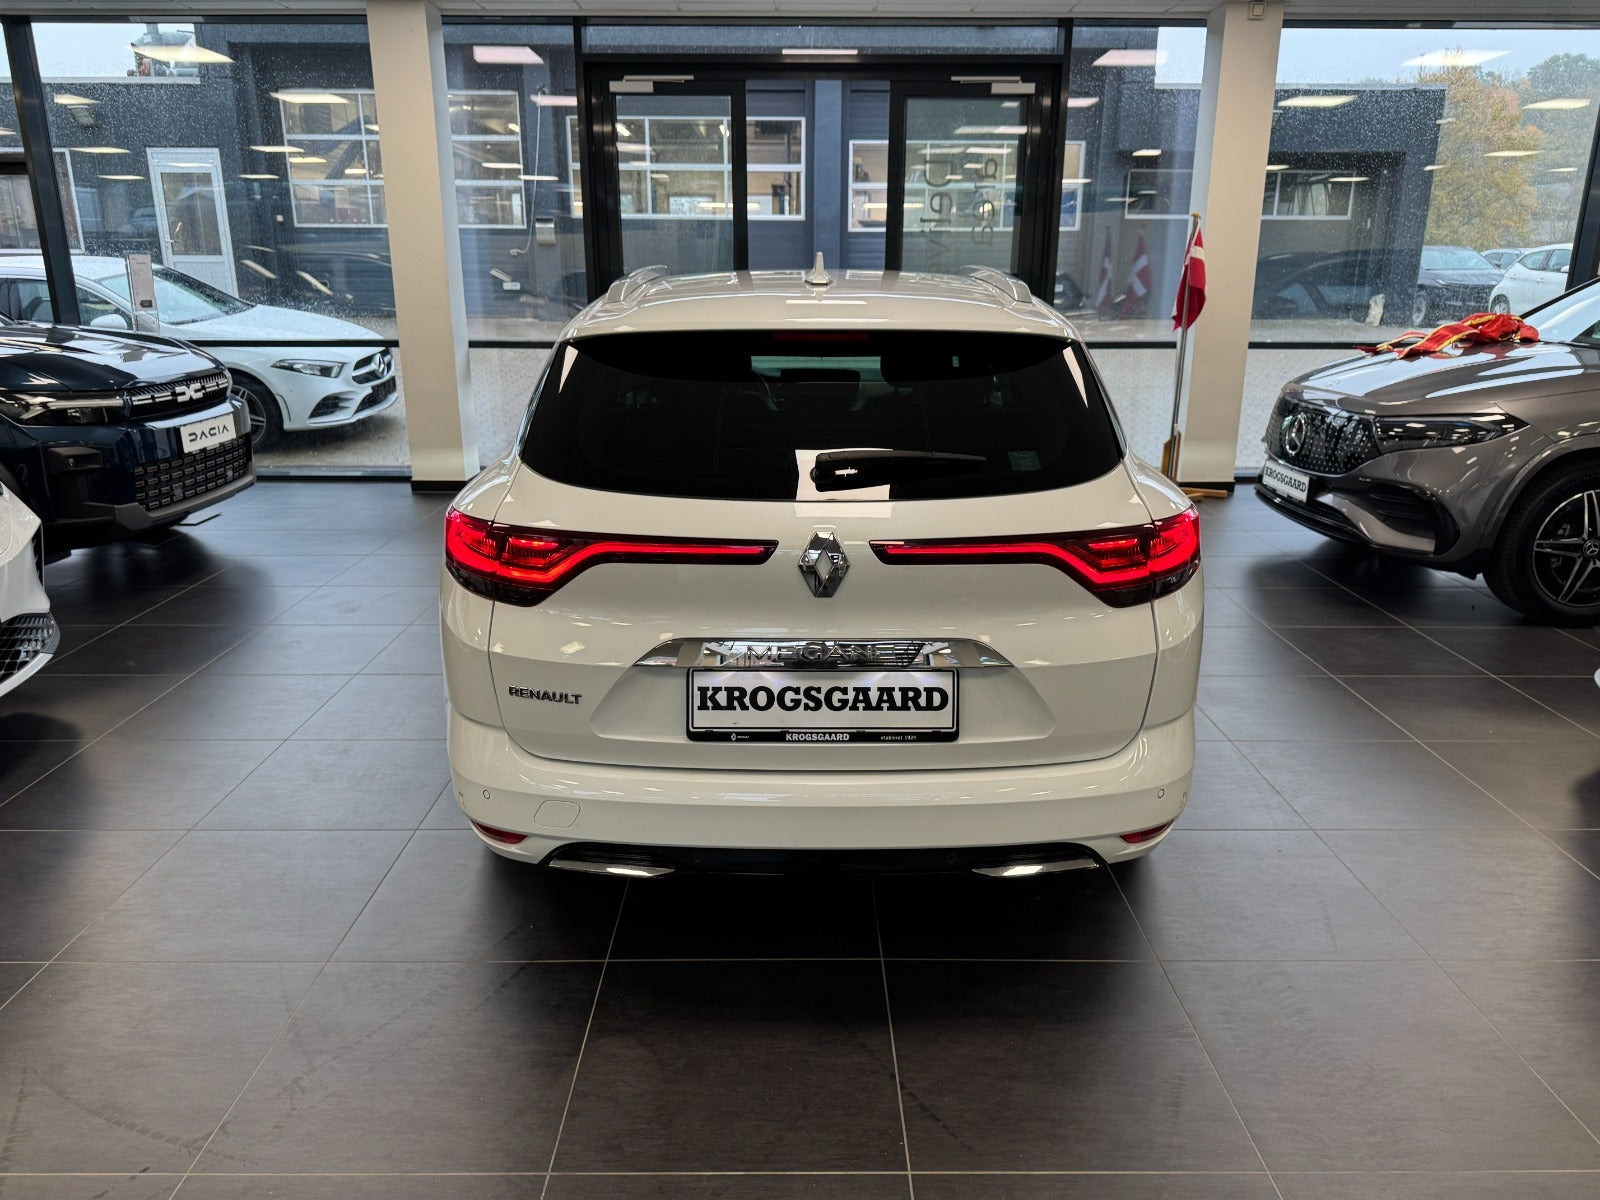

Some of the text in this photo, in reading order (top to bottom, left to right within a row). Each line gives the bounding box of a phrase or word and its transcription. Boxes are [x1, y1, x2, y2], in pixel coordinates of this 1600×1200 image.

[188, 424, 230, 443] DACIA
[1264, 466, 1307, 493] KROGSGAARD
[508, 685, 582, 705] RENAULT
[697, 686, 949, 711] KROGSGAARD
[785, 733, 850, 741] KROGSGAARD
